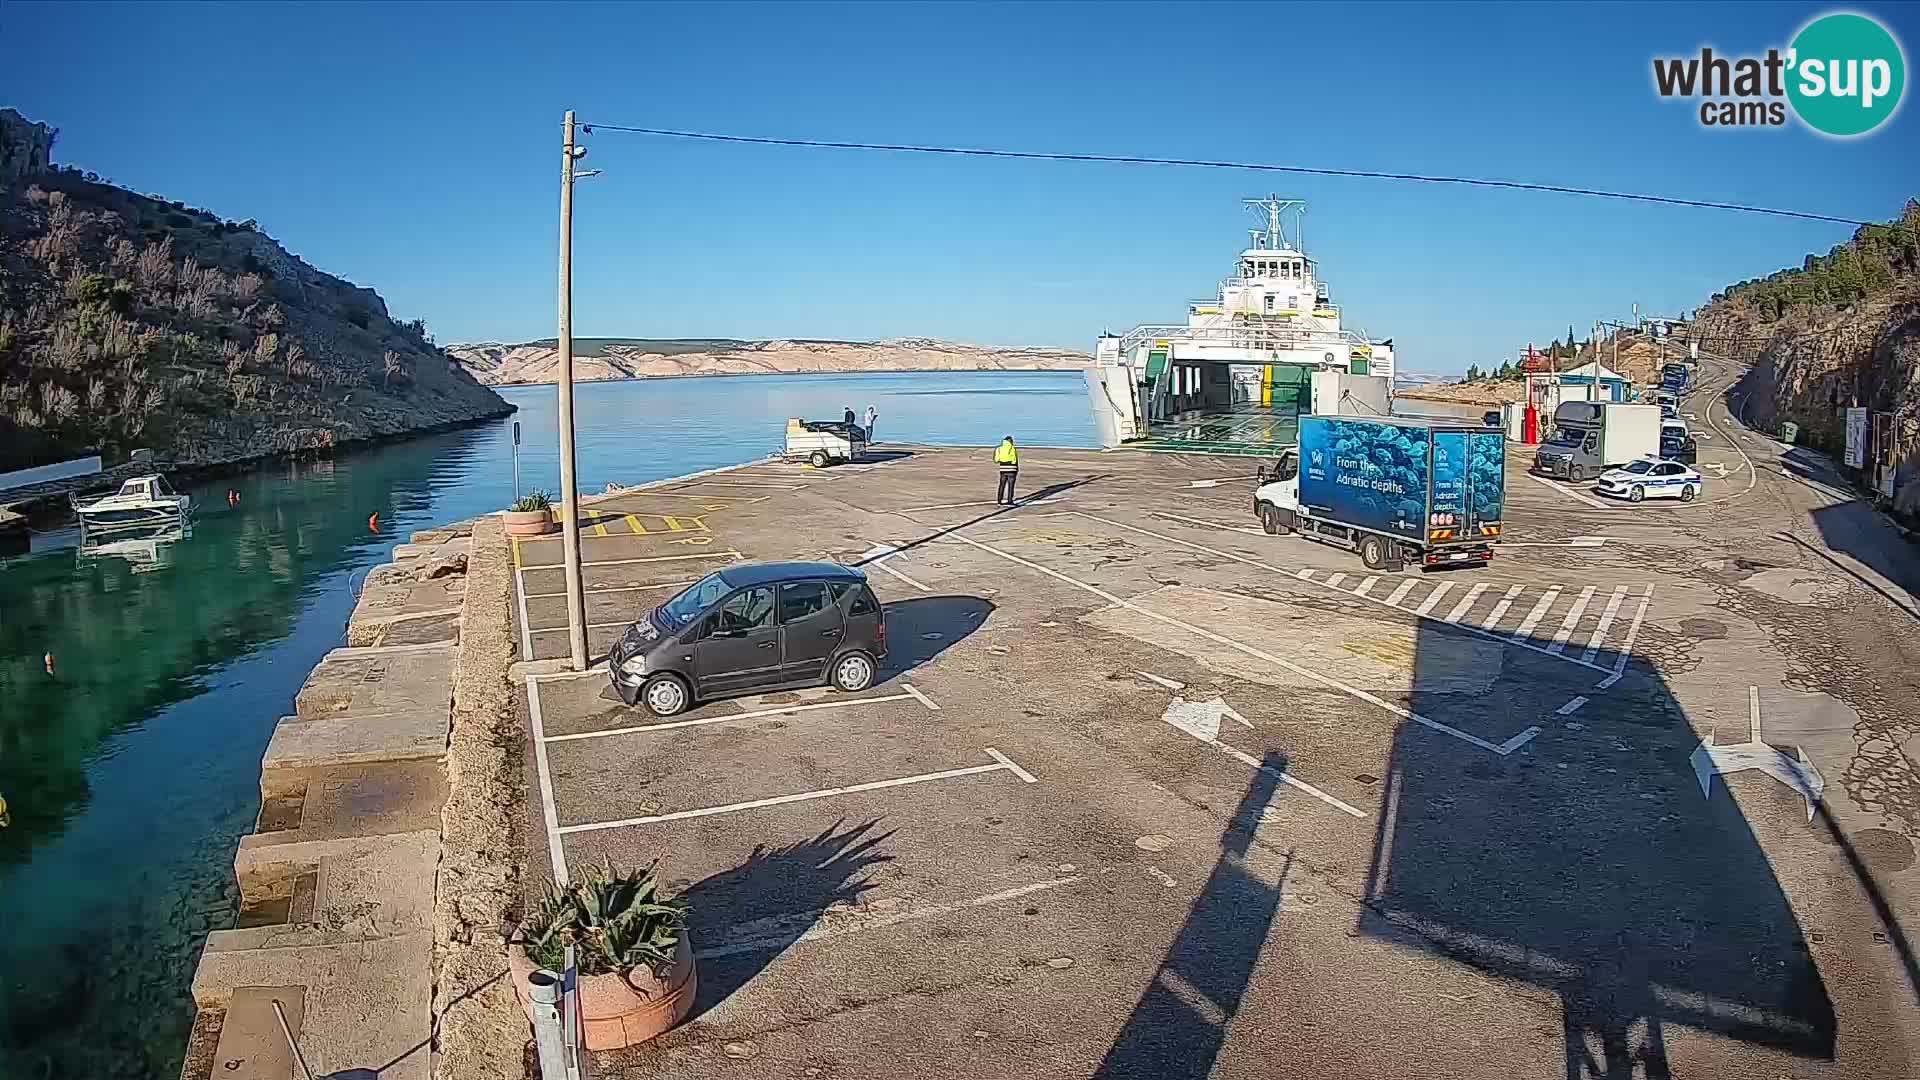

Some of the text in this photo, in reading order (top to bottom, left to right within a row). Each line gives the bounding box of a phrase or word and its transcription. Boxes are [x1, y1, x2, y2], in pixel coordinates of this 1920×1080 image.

[1336, 456, 1375, 471] From the
[1336, 473, 1406, 495] Adriatic depths.
